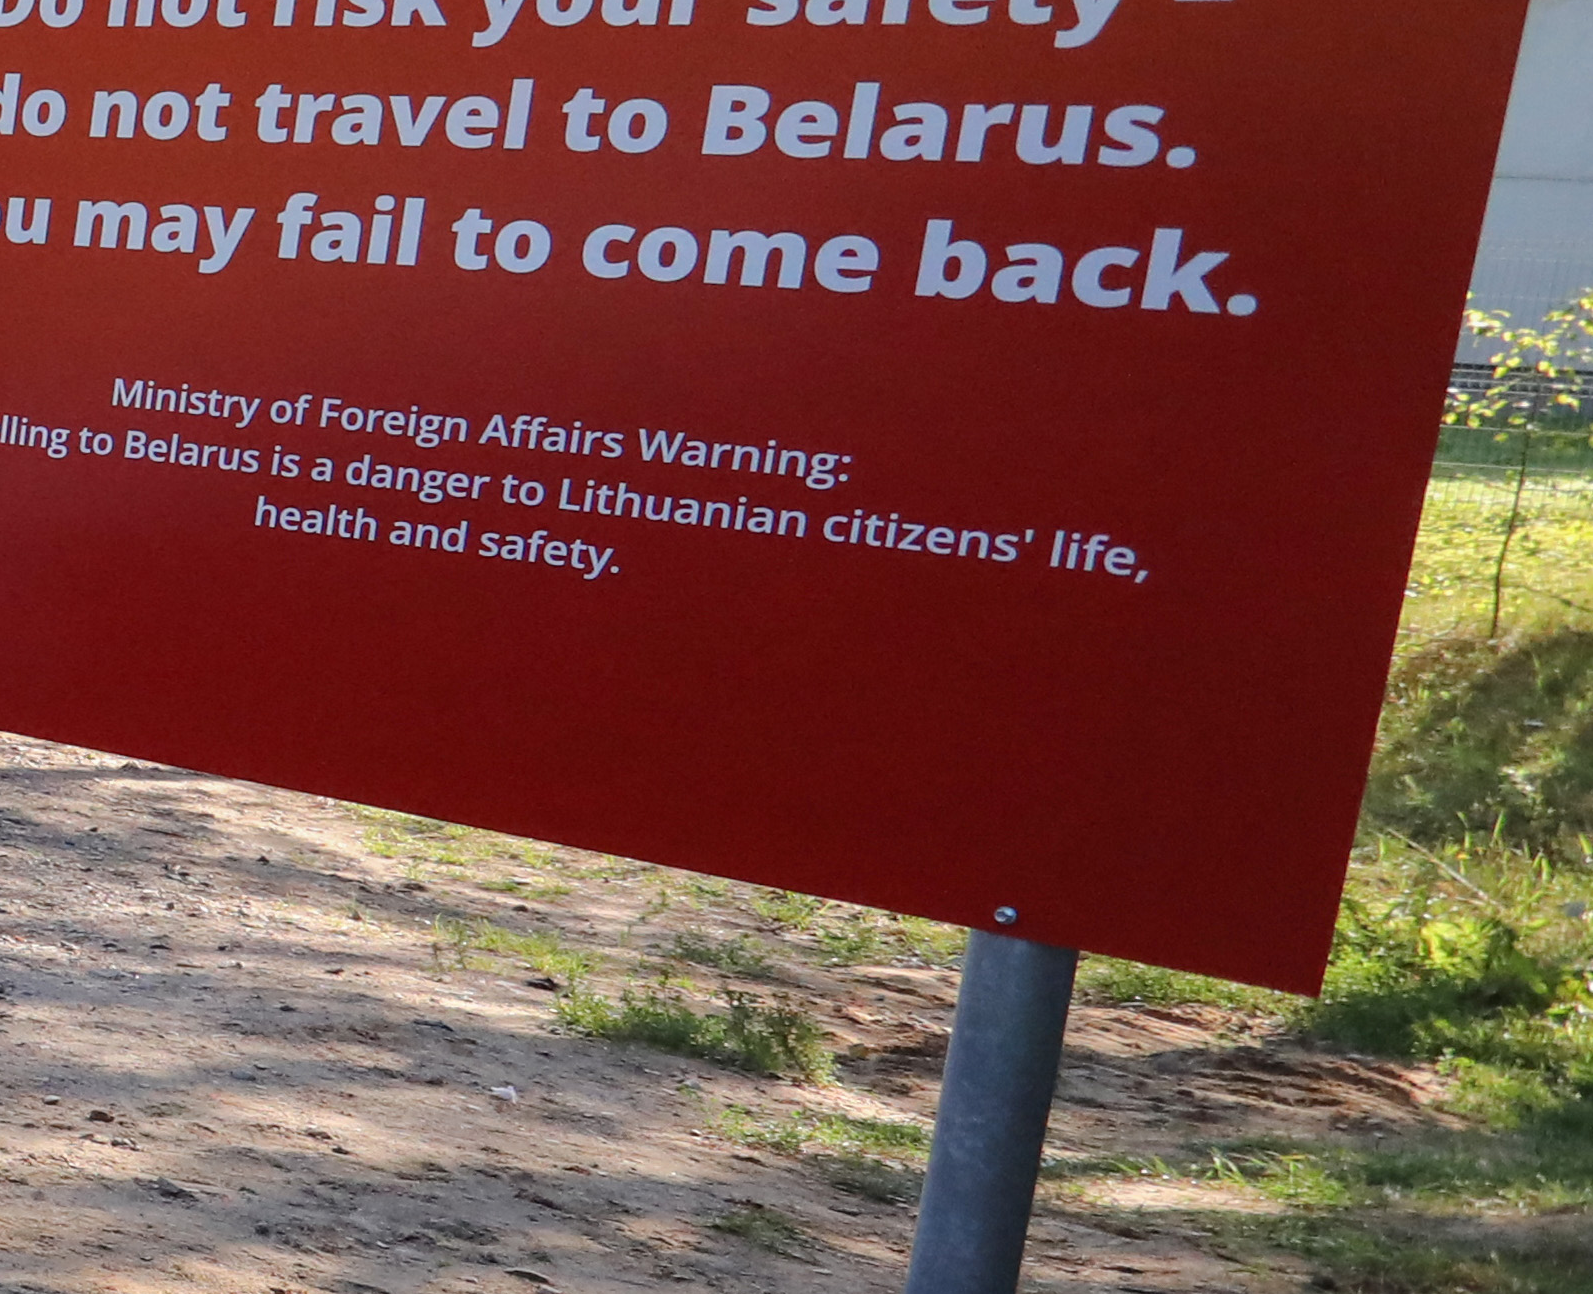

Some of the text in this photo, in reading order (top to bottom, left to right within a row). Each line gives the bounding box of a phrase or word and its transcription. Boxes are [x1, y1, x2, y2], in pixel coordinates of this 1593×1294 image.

[90, 84, 230, 141] not
[255, 79, 533, 149] travel
[562, 89, 667, 153] to
[702, 82, 1195, 168] Belarus.
[74, 201, 255, 273] may
[277, 193, 425, 265] fail
[452, 209, 550, 273] to
[583, 225, 878, 292] come
[915, 219, 1256, 315] back.
[111, 378, 851, 489] Ministry of Foreign Affairs Warning:
[78, 427, 113, 456] to
[125, 431, 259, 472] Belarus
[271, 446, 300, 477] is
[311, 458, 333, 482] a
[346, 455, 490, 503] danger
[502, 475, 544, 505] to
[559, 479, 805, 537] Lithuanian
[824, 509, 1033, 561] citizens'
[1051, 531, 1148, 584] life,
[255, 496, 619, 579] health and safety.
